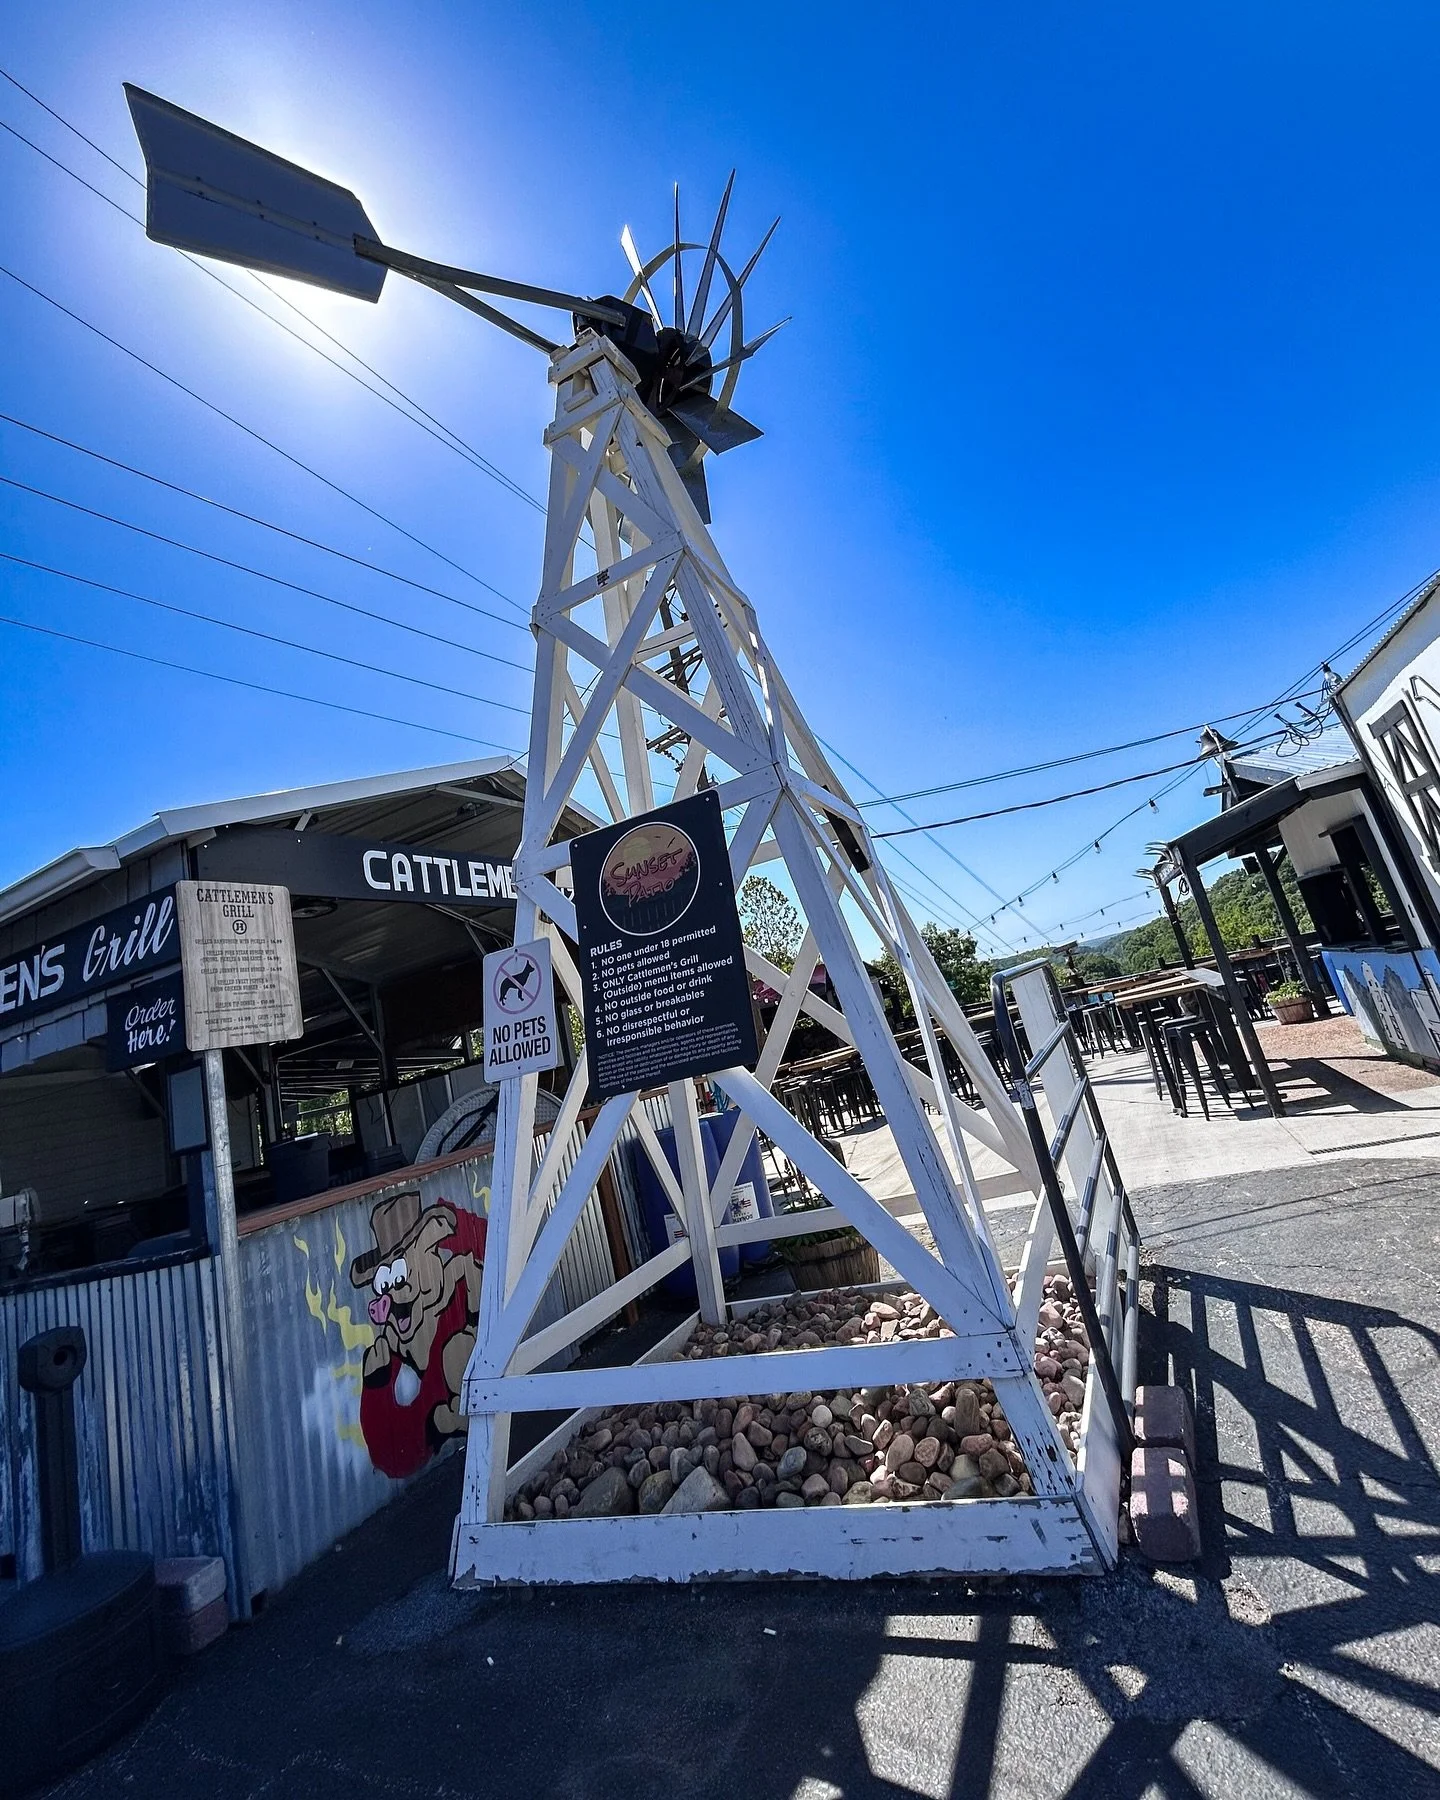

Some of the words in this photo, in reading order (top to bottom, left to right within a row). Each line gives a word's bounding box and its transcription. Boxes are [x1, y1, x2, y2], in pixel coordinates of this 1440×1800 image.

[363, 850, 574, 900] CATTLEME
[610, 848, 683, 887] SUNSET
[197, 888, 274, 905] CATTLEMEN'S
[623, 878, 674, 907] PATIO
[223, 905, 254, 918] GRILL
[83, 896, 174, 982] Grill
[590, 939, 623, 957] RULES
[591, 961, 598, 970] 1.
[601, 956, 615, 967] NO
[616, 952, 632, 962] one
[633, 944, 659, 956] under
[660, 939, 670, 948] 18
[672, 925, 716, 946] permitted
[592, 972, 600, 981] 2.
[601, 967, 615, 978] NO
[616, 962, 635, 975] pets
[636, 950, 670, 968] allowed
[593, 983, 601, 992] 3.
[602, 975, 625, 989] ONLY
[627, 961, 678, 982] Cattlemen's
[680, 954, 699, 967] Grill
[603, 981, 642, 1000] (Outside)
[644, 975, 668, 988] menu
[670, 967, 695, 980] items
[697, 955, 733, 973] allowed
[594, 1005, 603, 1013] 4.
[604, 1000, 618, 1011] NO
[620, 991, 652, 1007] outside
[654, 983, 675, 998] food
[676, 982, 687, 990] or
[688, 974, 713, 988] drink
[595, 1016, 604, 1026] 5.
[605, 1012, 619, 1023] NO
[620, 1006, 643, 1020] glass
[644, 1003, 654, 1012] or
[655, 990, 705, 1009] breakables
[125, 997, 176, 1030] Order
[596, 1030, 605, 1039] 6.
[606, 1025, 620, 1036] NO
[622, 1009, 678, 1032] disrespectful
[680, 1007, 690, 1016] or
[128, 1019, 176, 1054] Here!
[493, 1024, 510, 1045] NO
[514, 1016, 546, 1040] PETS
[606, 1025, 662, 1047] irresponsible
[664, 1015, 705, 1032] behavior
[489, 1036, 551, 1067] ALLOWED
